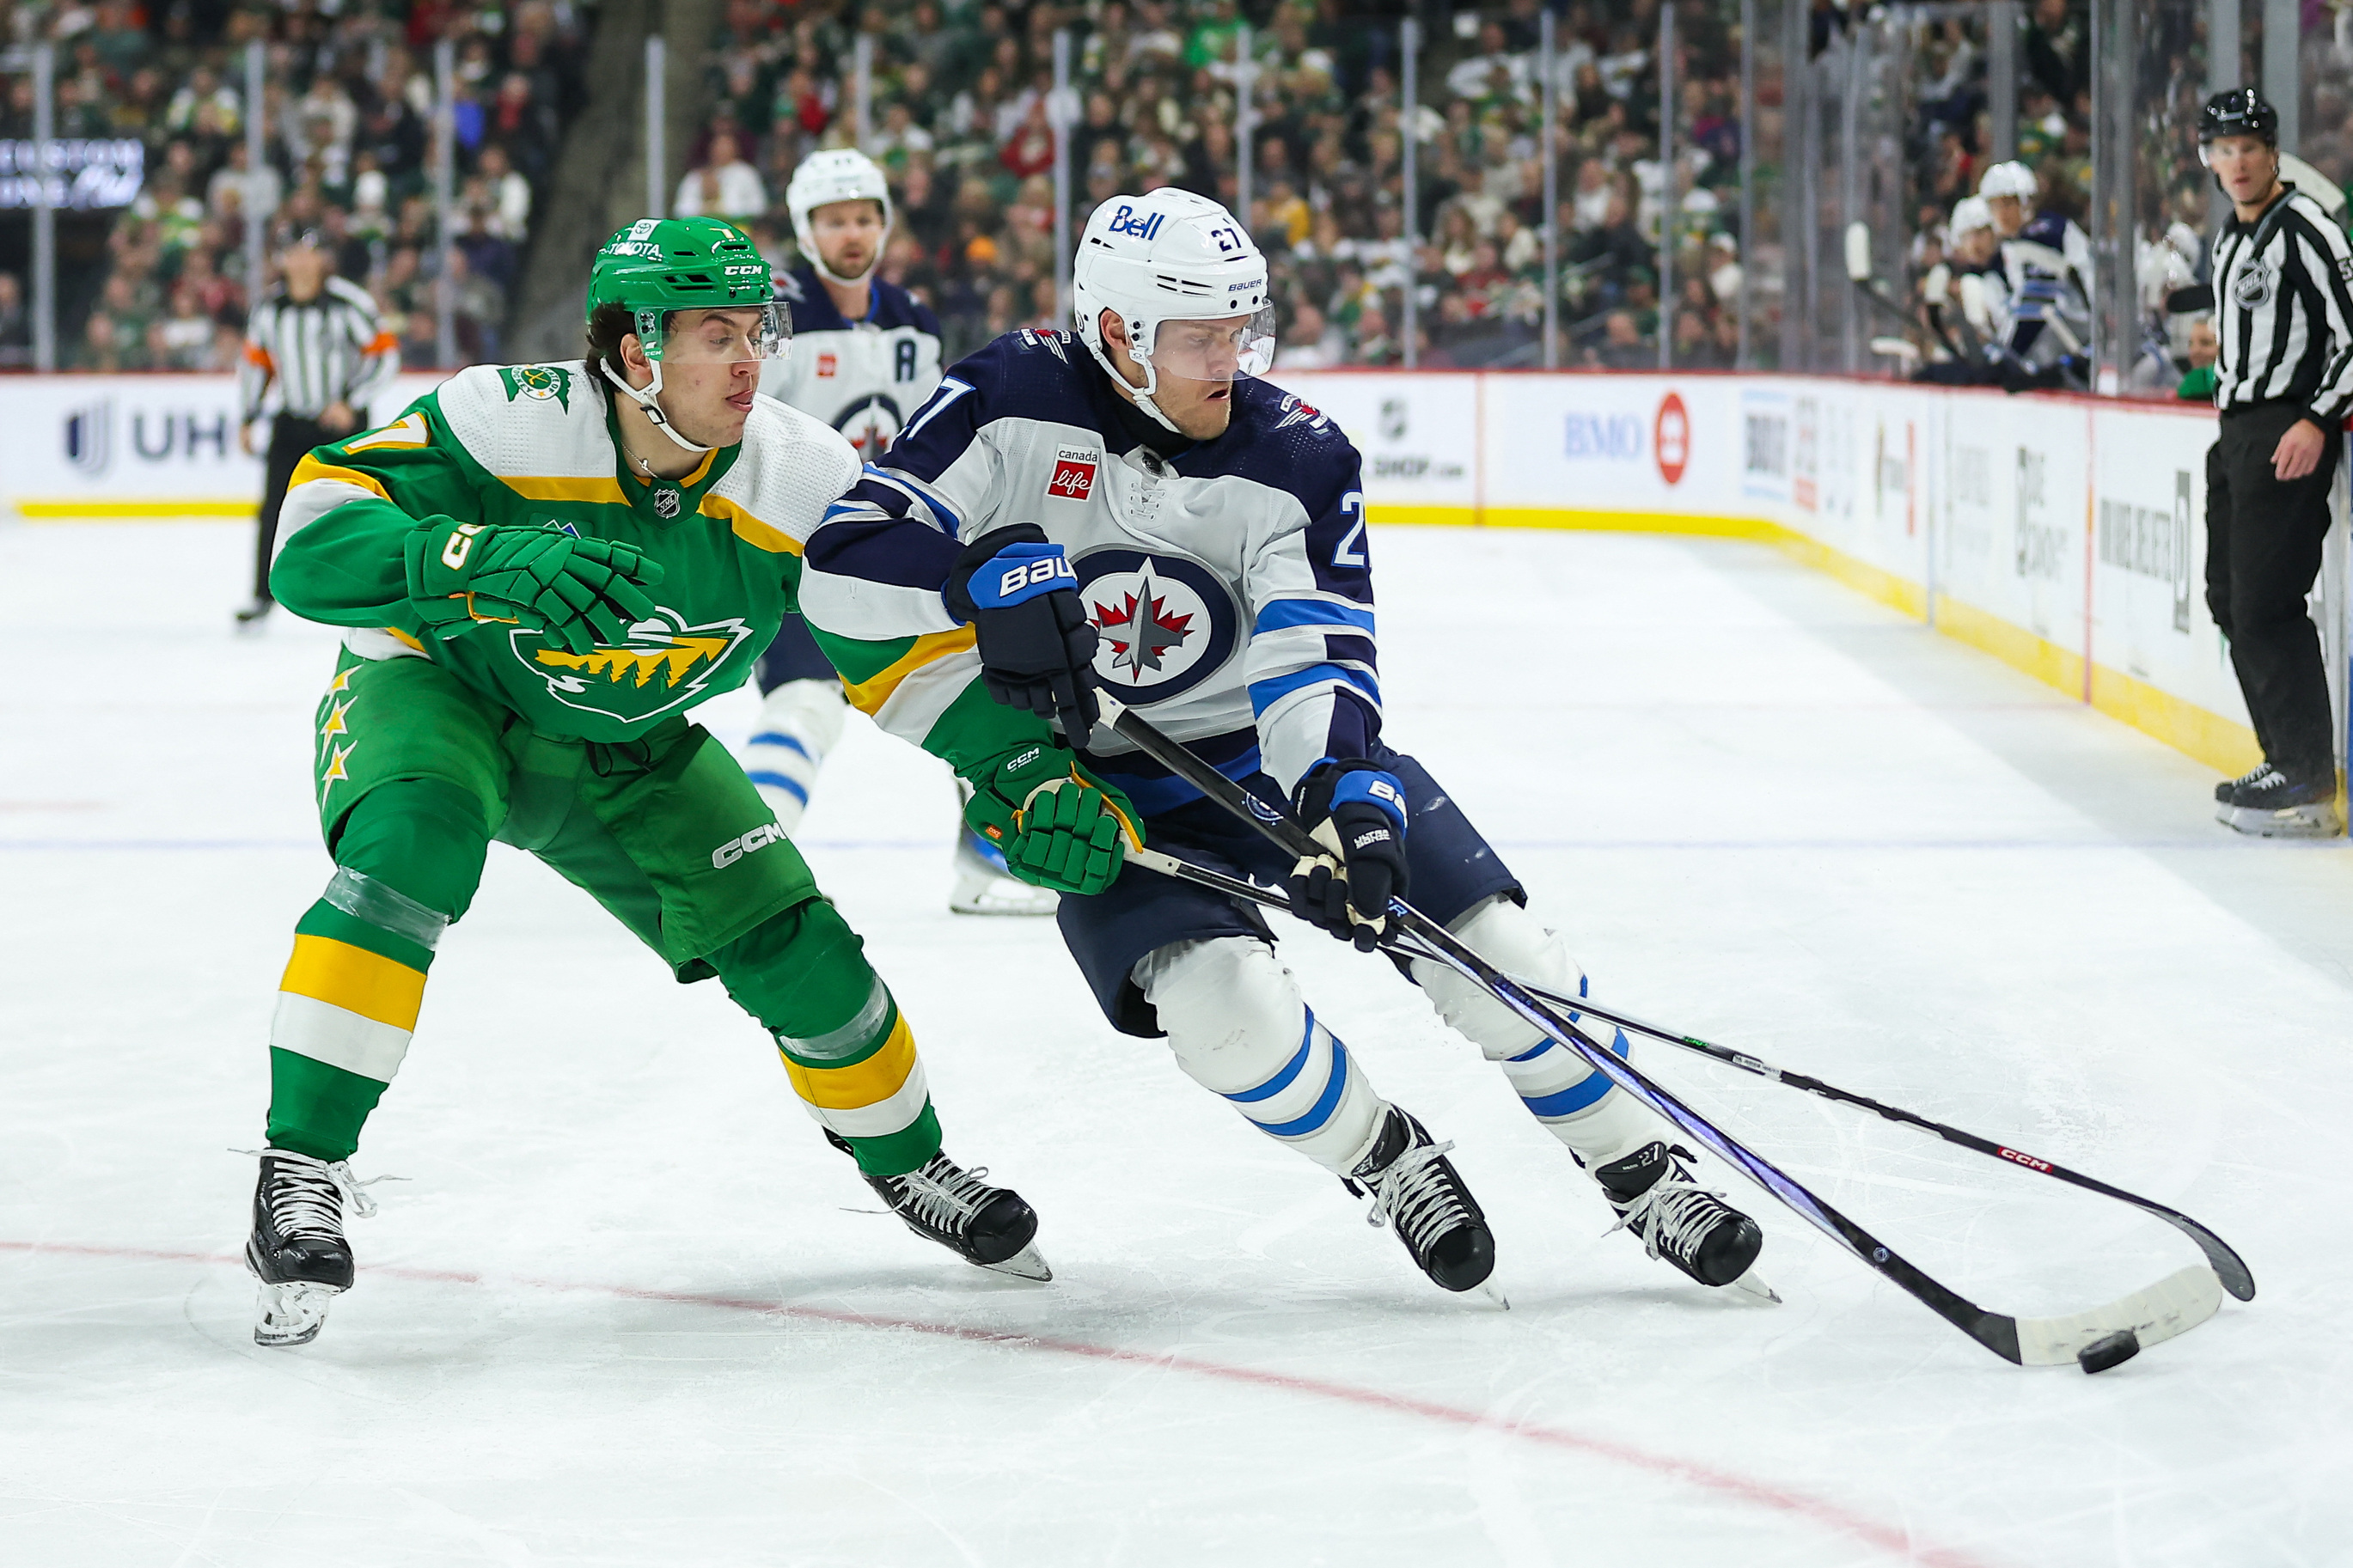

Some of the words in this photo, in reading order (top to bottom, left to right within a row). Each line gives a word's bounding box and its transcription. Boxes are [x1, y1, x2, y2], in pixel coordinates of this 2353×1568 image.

[1109, 205, 1165, 241] Bell
[608, 241, 661, 256] TOYOTA
[1211, 227, 1242, 252] 27
[724, 265, 763, 275] CCM
[895, 339, 916, 381] A
[513, 366, 534, 393] HOCKEY
[342, 412, 431, 455] 7
[1564, 412, 1645, 460] BMO
[1059, 449, 1098, 461] canada
[1052, 469, 1091, 494] life
[1006, 747, 1040, 771] CCM
[712, 822, 787, 869] CCM
[2000, 1148, 2049, 1171] CCM
